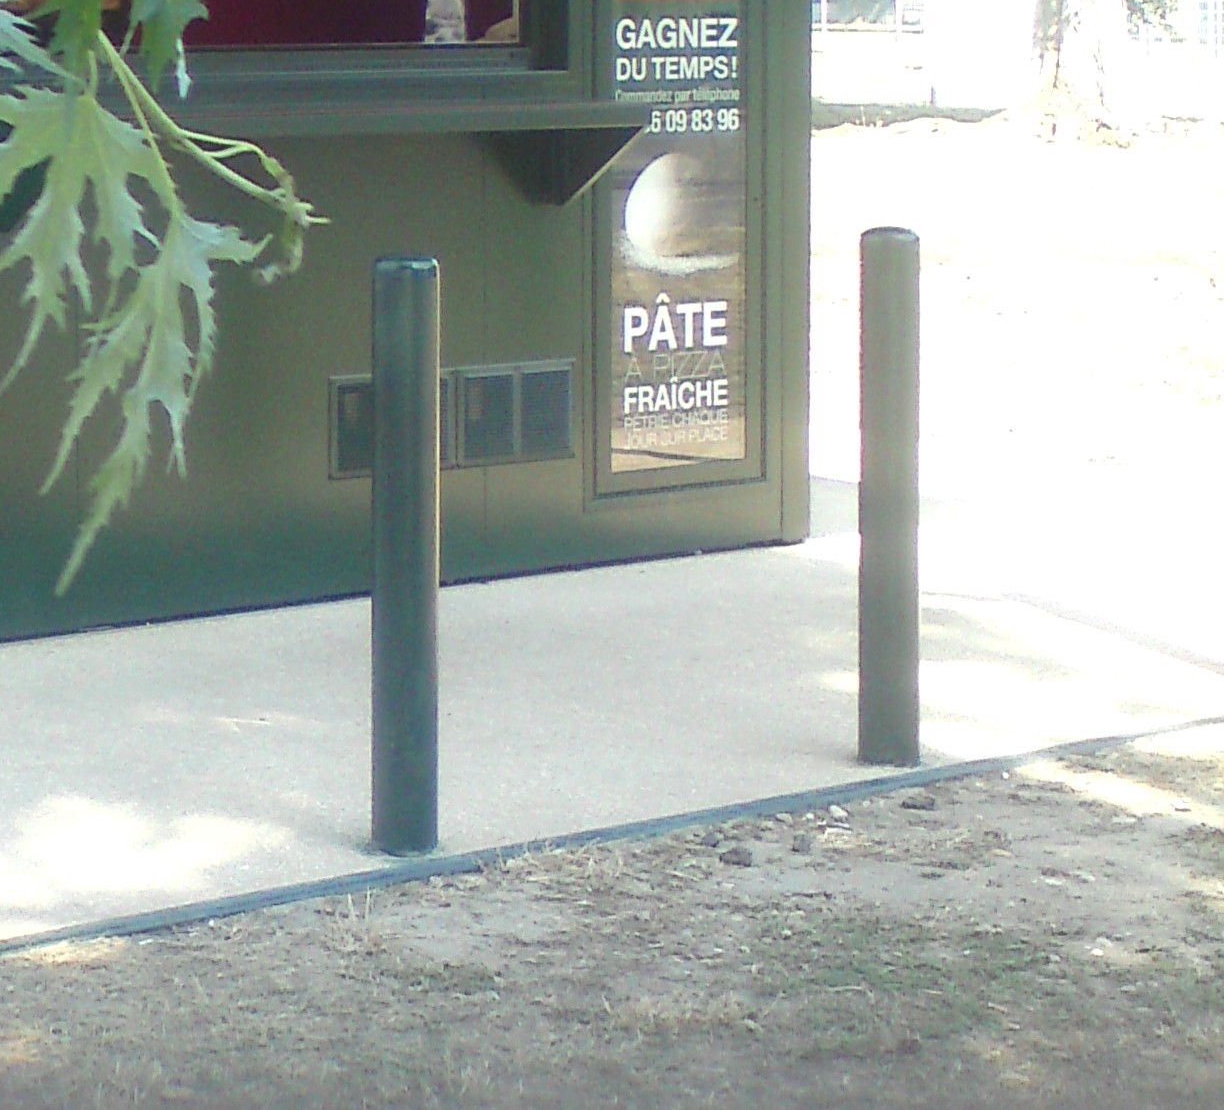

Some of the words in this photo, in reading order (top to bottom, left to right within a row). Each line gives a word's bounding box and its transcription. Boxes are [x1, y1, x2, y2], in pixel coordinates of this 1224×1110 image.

[616, 18, 739, 49] GAGNEZ
[616, 57, 646, 81] DU
[665, 110, 687, 133] 09
[691, 109, 713, 132] 83
[717, 108, 740, 131] 96
[624, 292, 728, 354] PÂTE
[653, 349, 728, 381] PIZZA
[624, 376, 728, 414] FRAÎCHE
